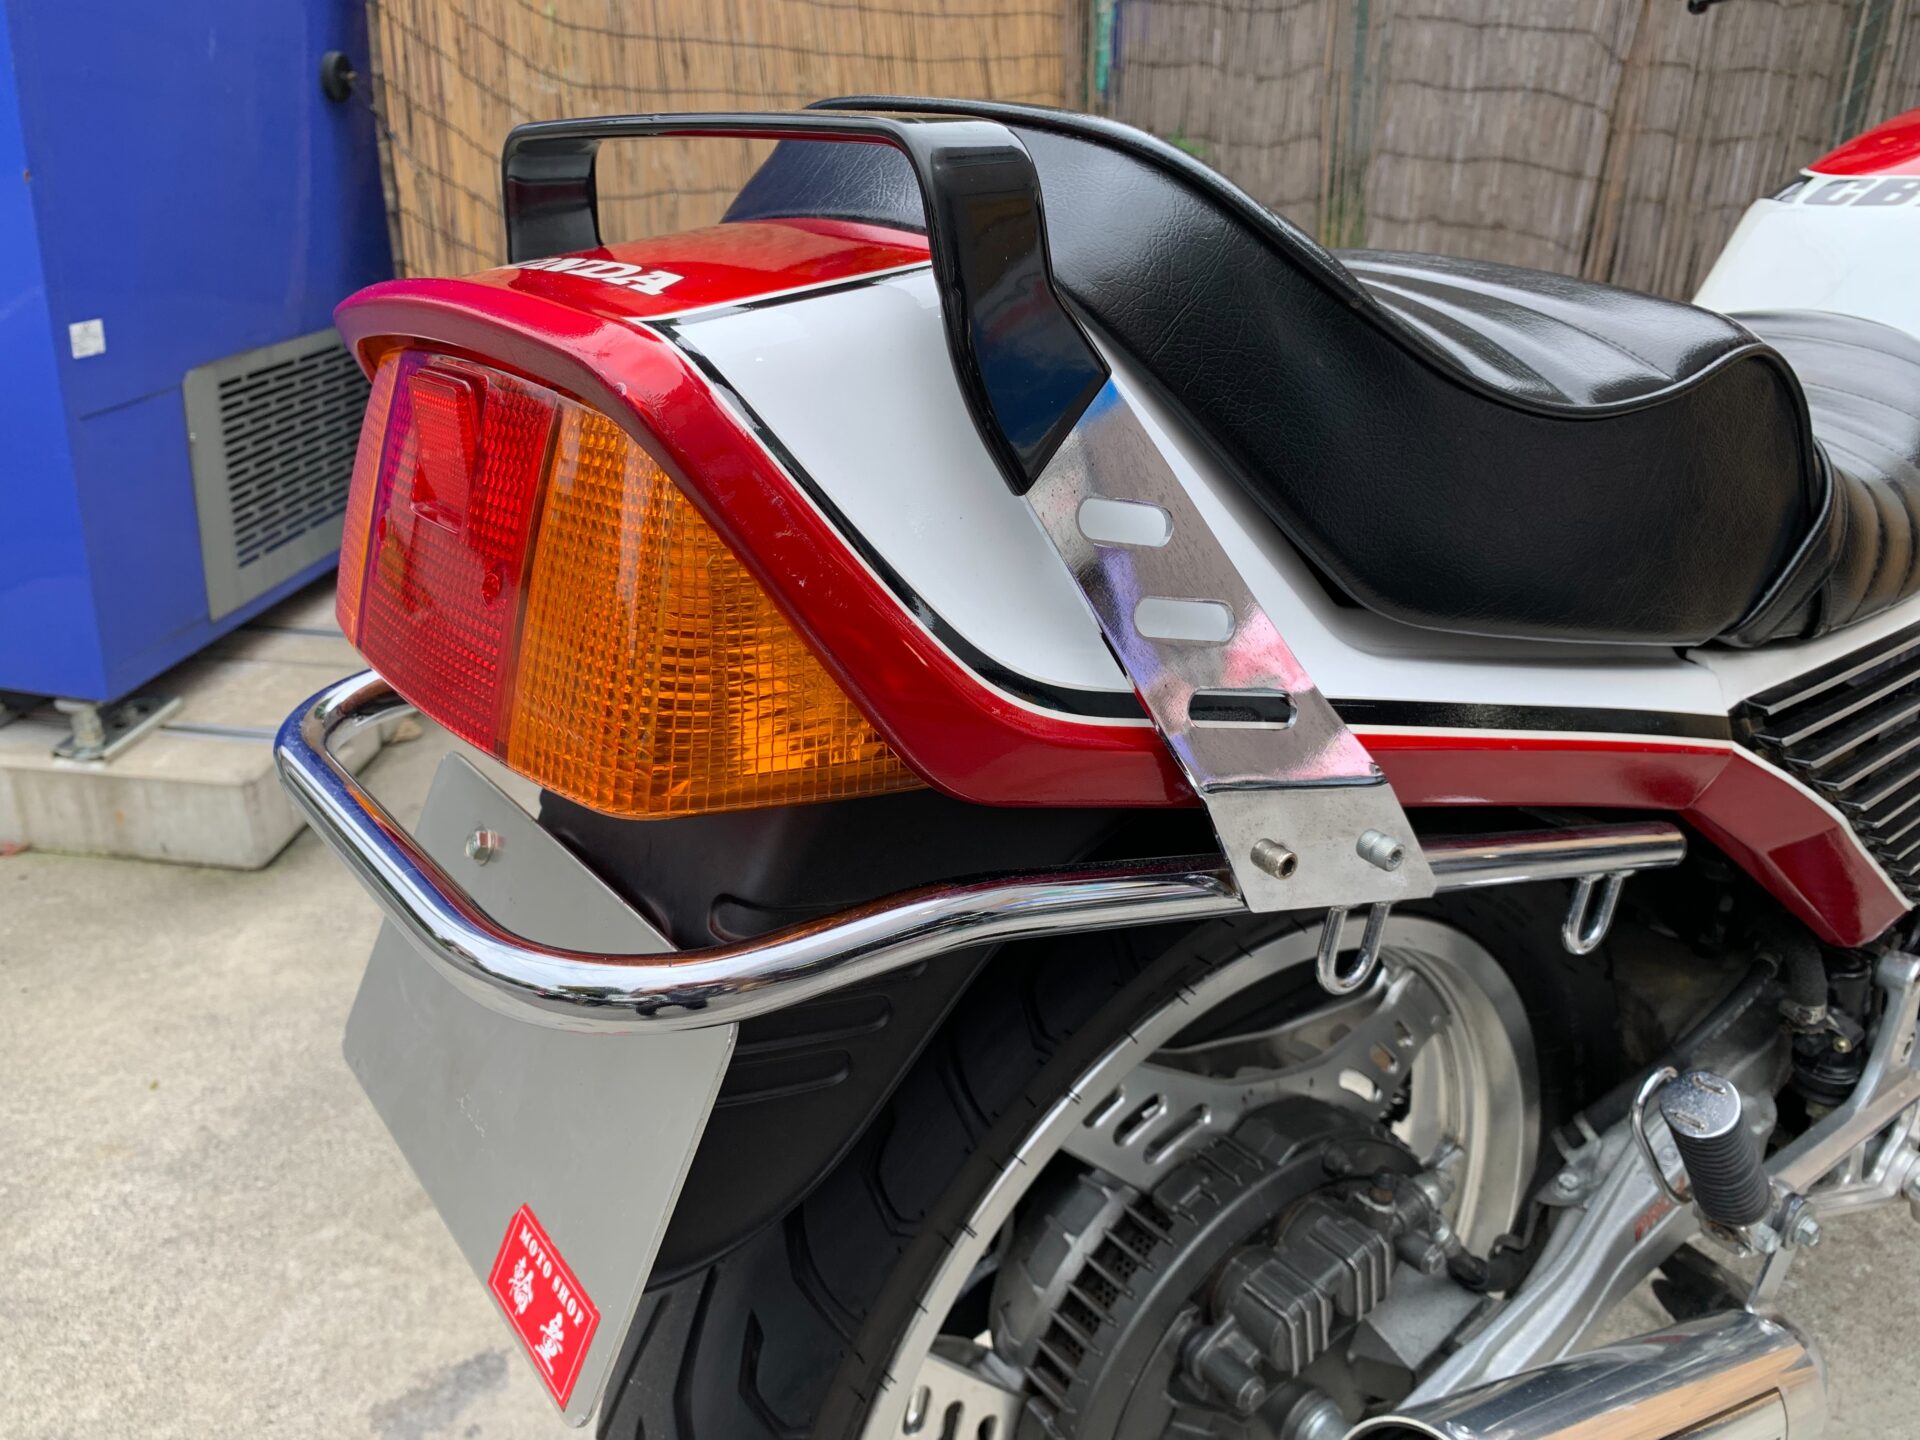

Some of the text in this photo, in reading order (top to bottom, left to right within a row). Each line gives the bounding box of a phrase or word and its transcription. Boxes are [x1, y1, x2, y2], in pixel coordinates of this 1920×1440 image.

[1803, 179, 1920, 206] CB
[519, 1225, 585, 1328] MOTO SHOP
